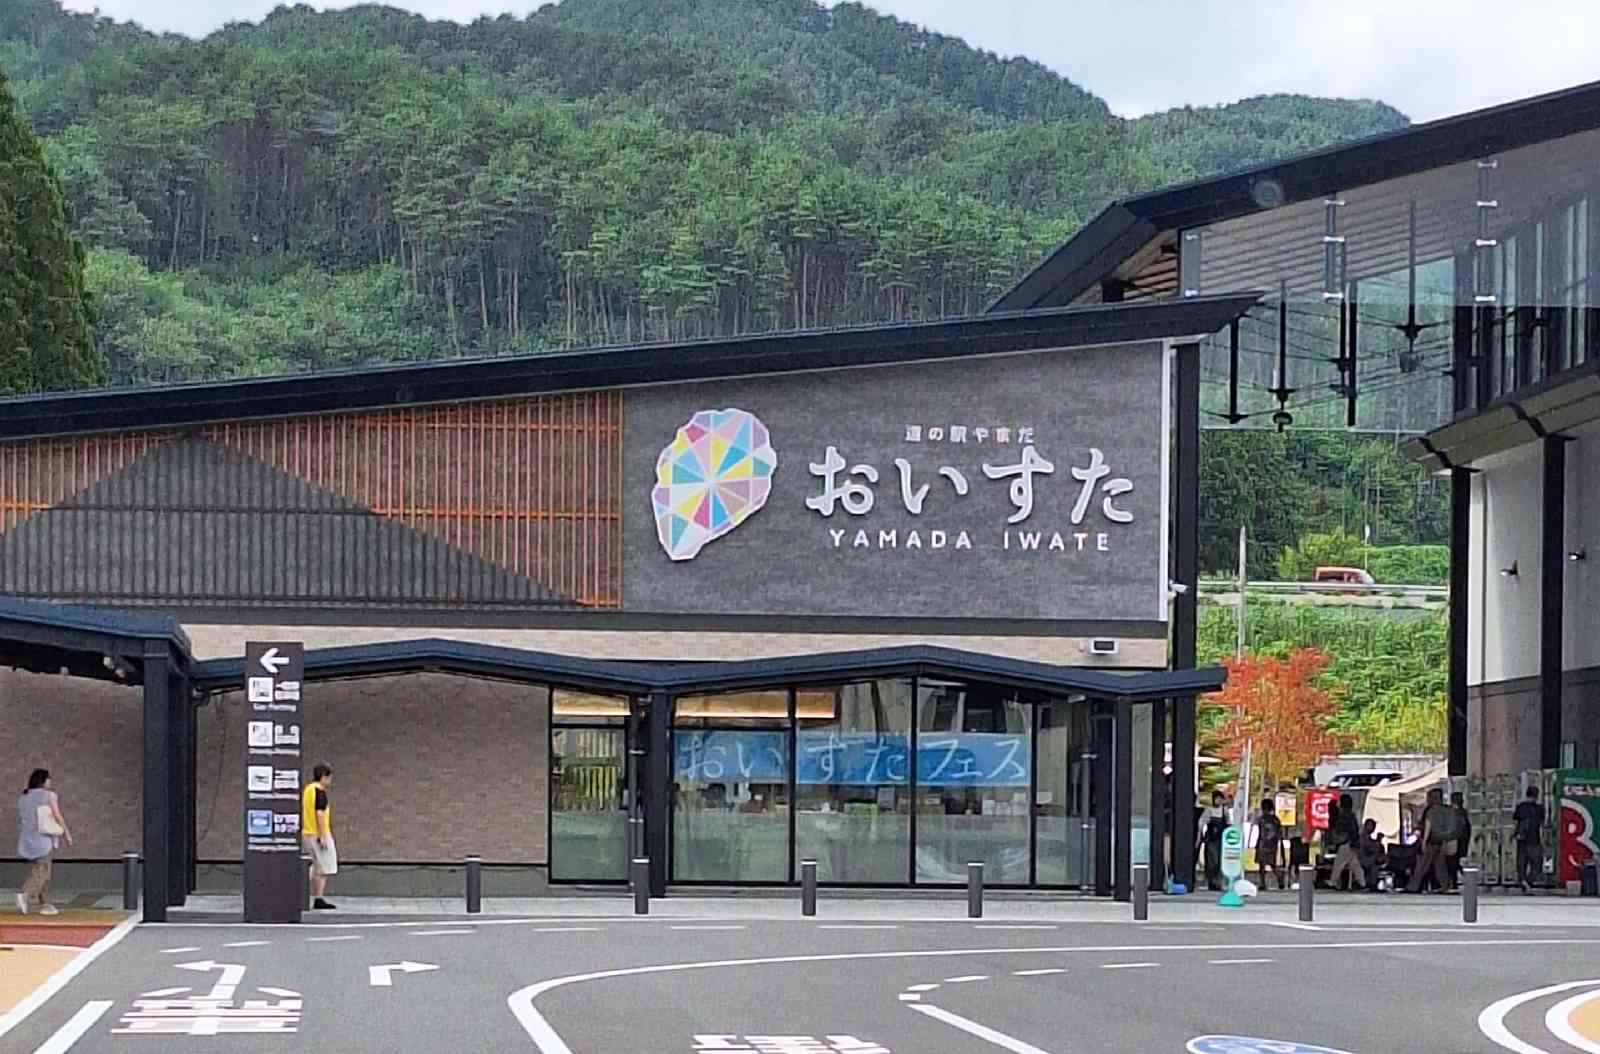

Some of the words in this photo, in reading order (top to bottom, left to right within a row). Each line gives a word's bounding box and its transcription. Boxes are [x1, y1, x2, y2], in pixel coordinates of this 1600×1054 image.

[905, 425, 1034, 443] 道の駅やまだ
[805, 446, 1134, 524] おいすた
[829, 530, 972, 550] YAMADA
[1004, 532, 1110, 551] IWATE
[681, 734, 1026, 780] おいすたフェス
